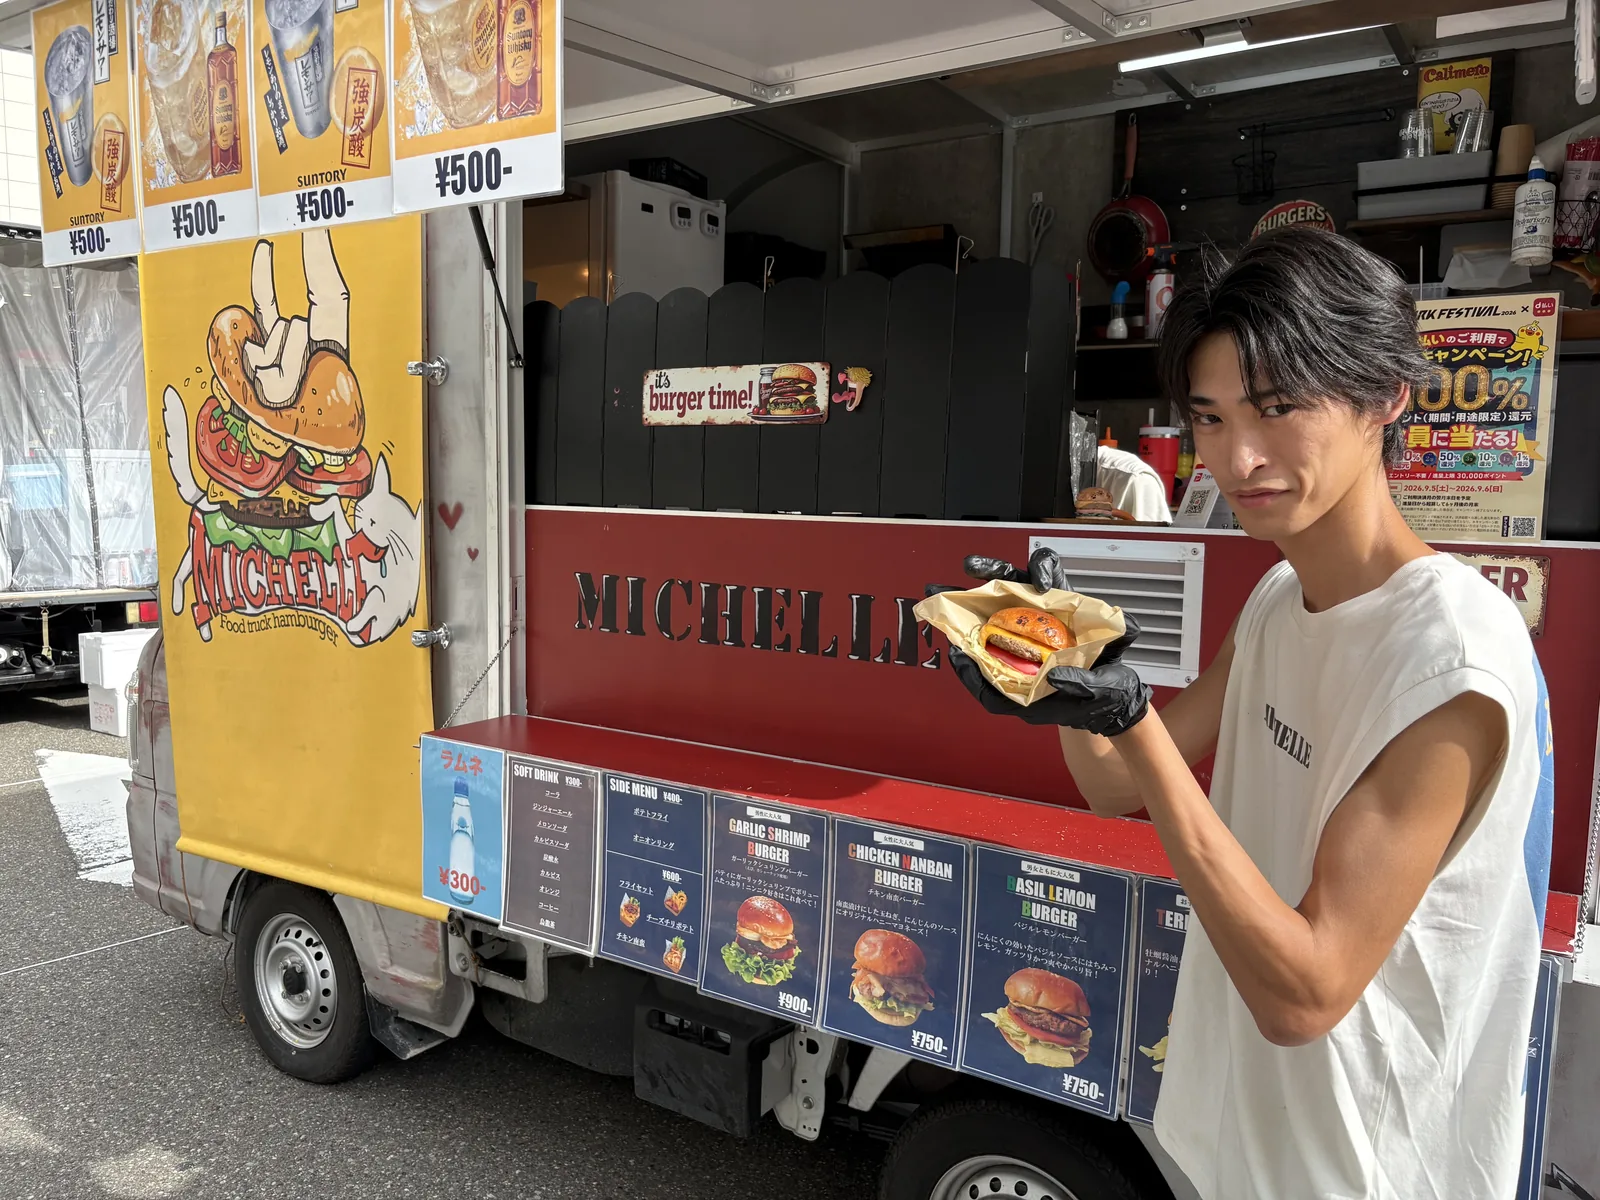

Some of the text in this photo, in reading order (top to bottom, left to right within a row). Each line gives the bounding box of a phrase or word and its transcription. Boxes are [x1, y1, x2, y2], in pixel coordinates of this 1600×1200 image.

[507, 40, 532, 55] Whisky
[1423, 64, 1490, 83] Calimero
[347, 78, 370, 158] 強炭酸
[104, 138, 120, 204] 強炭酸
[435, 147, 513, 198] ¥500-
[295, 186, 354, 223] ¥500-
[171, 199, 225, 239] ¥500-
[1258, 205, 1326, 235] BURGERS
[69, 226, 111, 255] ¥500-
[1437, 305, 1500, 319] FESTIVAL
[654, 371, 671, 389] it's
[649, 385, 707, 418] burger
[708, 380, 754, 410] time!
[1403, 423, 1517, 449] 員に当たる!
[1440, 452, 1460, 461] 50%
[1479, 452, 1496, 461] 10%
[1516, 452, 1529, 461] 1%
[219, 611, 339, 647] Food truck hamburger
[573, 572, 941, 670] MICHELLE
[440, 749, 483, 776] ラムネ
[513, 764, 583, 787] SOFT DRINK ¥300-
[545, 789, 561, 798] コーラ
[609, 777, 683, 803] SIDE MENU ¥400-
[537, 819, 568, 832] メロンソーダ
[633, 807, 669, 822] ポテトフライ
[633, 833, 675, 850] オニオンリング
[729, 818, 811, 848] GARLIC SHRIMP
[747, 841, 790, 864] BURGER
[848, 842, 953, 879] CHICKEN NANBAN
[438, 866, 487, 896] ¥300-
[662, 869, 683, 882] ¥600-
[874, 868, 923, 893] BURGER
[1026, 864, 1075, 881] 男女ともに大人気
[539, 885, 560, 896] オレンジ
[619, 880, 655, 895] フライセット
[868, 888, 925, 906] チキン南蛮バーガー
[1006, 875, 1097, 910] BASIL LEMON
[538, 902, 559, 912] コーヒー
[1021, 900, 1078, 928] BURGER
[616, 932, 646, 947] チキン南蛮
[1013, 921, 1088, 945] バジルレモンバーガー
[1144, 948, 1181, 964] 牡蠣醤油
[1144, 958, 1180, 972] ナルハニ
[778, 991, 812, 1015] ¥900-
[911, 1030, 948, 1054] ¥750-
[1062, 1072, 1105, 1101] ¥750-
